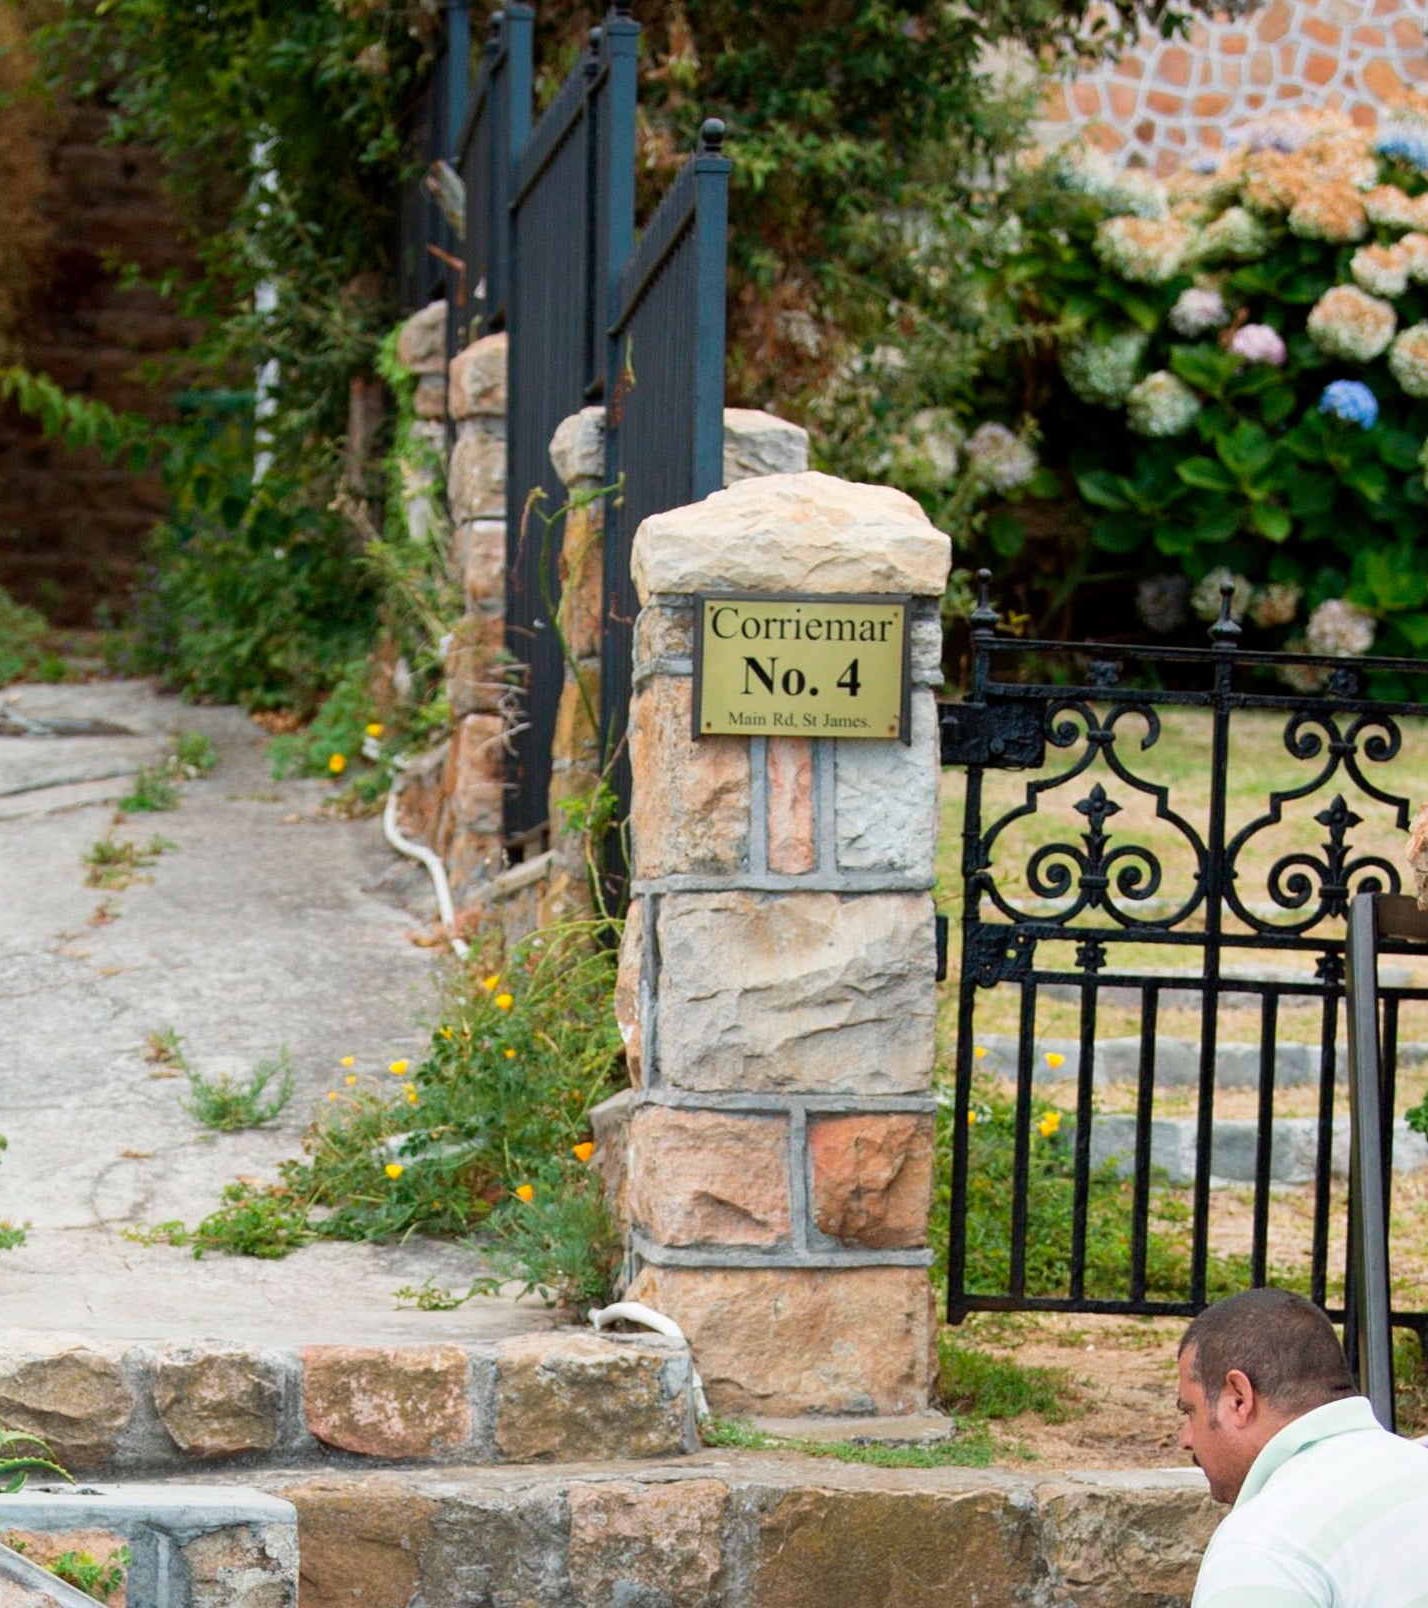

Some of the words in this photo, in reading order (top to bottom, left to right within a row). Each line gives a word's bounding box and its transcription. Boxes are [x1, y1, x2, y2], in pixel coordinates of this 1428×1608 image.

[711, 607, 893, 642] Corriemar
[740, 656, 819, 697] No.
[836, 657, 861, 697] 4
[728, 711, 767, 727] Main
[773, 712, 798, 730] Rd,
[802, 712, 817, 728] St
